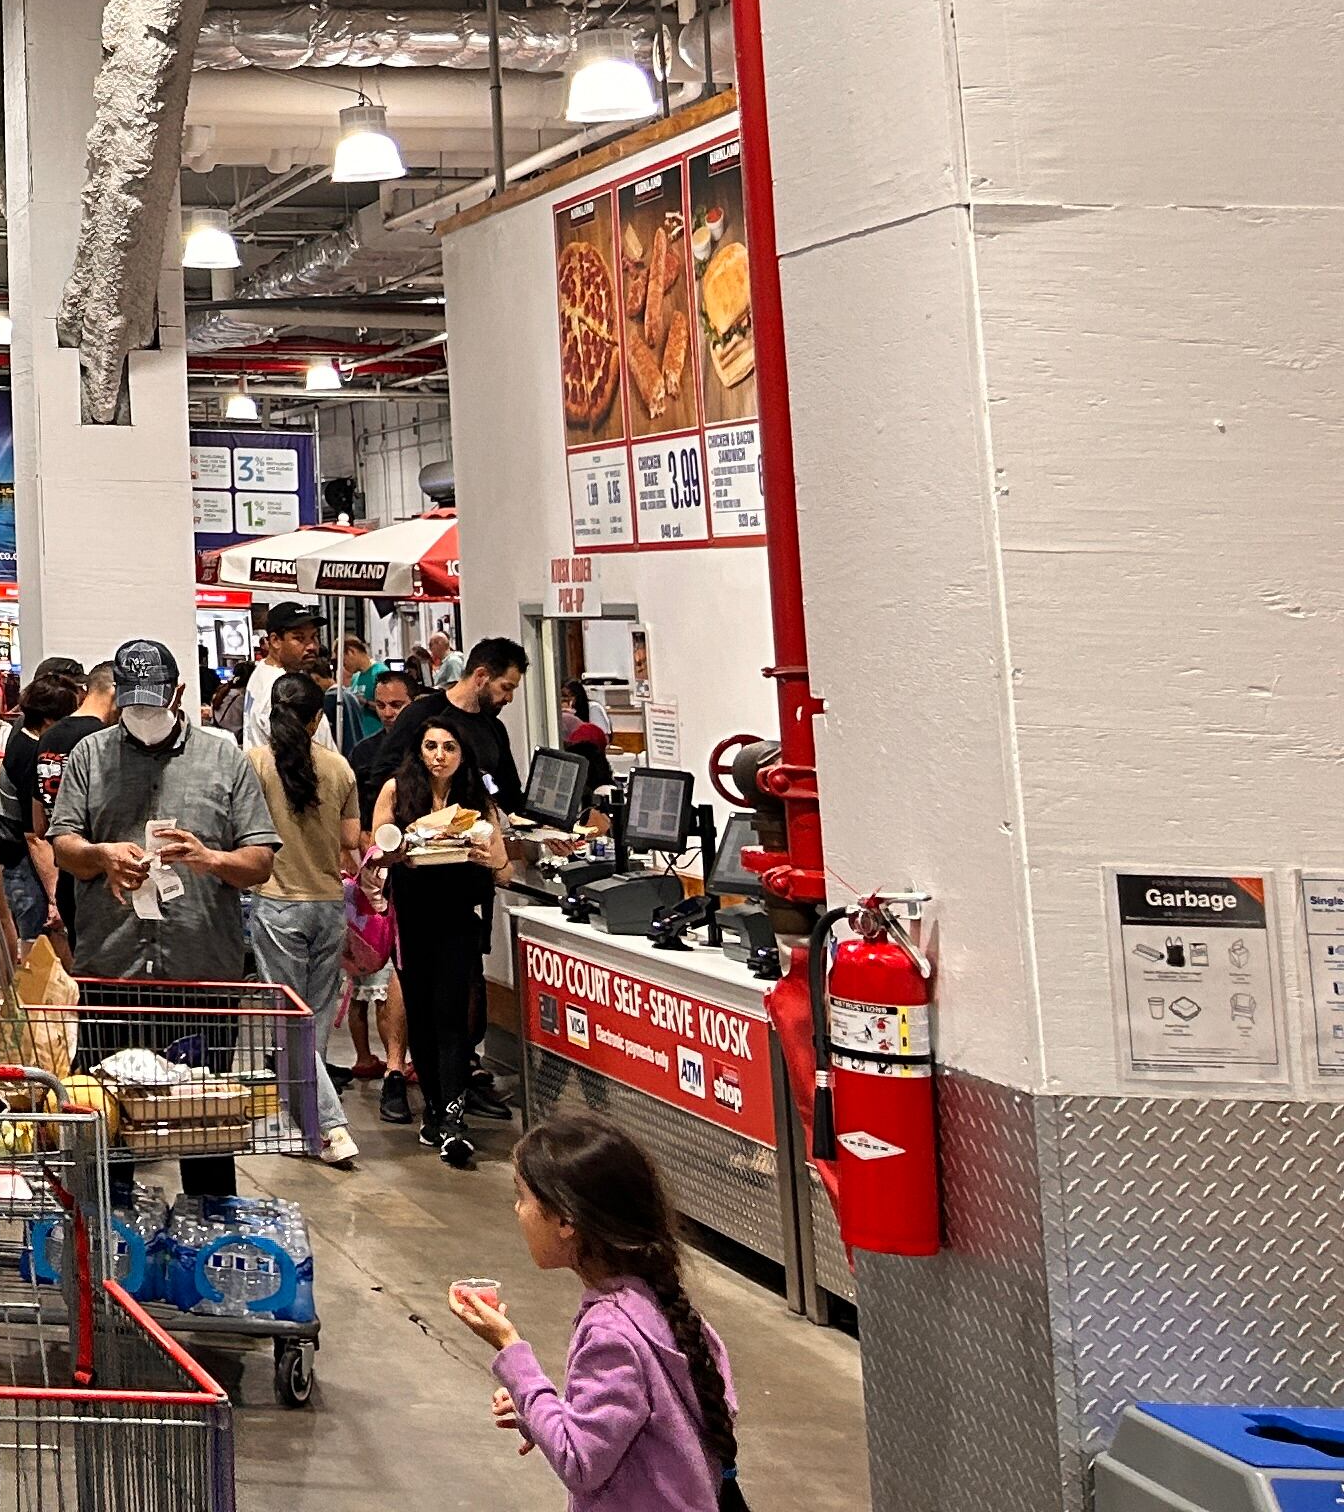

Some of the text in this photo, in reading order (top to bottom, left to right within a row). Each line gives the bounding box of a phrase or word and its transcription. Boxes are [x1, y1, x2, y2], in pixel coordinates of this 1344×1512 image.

[668, 447, 701, 510] 3.99
[321, 562, 387, 579] KIRKLAND
[551, 557, 592, 583] KIOSK ORDER
[558, 588, 584, 613] PICK-UP
[1145, 888, 1238, 912] Garbage
[526, 945, 752, 1061] FOOD COURT SELF-SERVE KIOSK
[833, 999, 888, 1015] INSTRUCTIONS
[569, 1015, 586, 1037] VISA
[901, 1013, 907, 1025] A
[595, 1024, 669, 1073] Electronic payments only
[902, 1036, 908, 1047] B
[681, 1058, 702, 1087] ATM
[713, 1076, 742, 1113] shop
